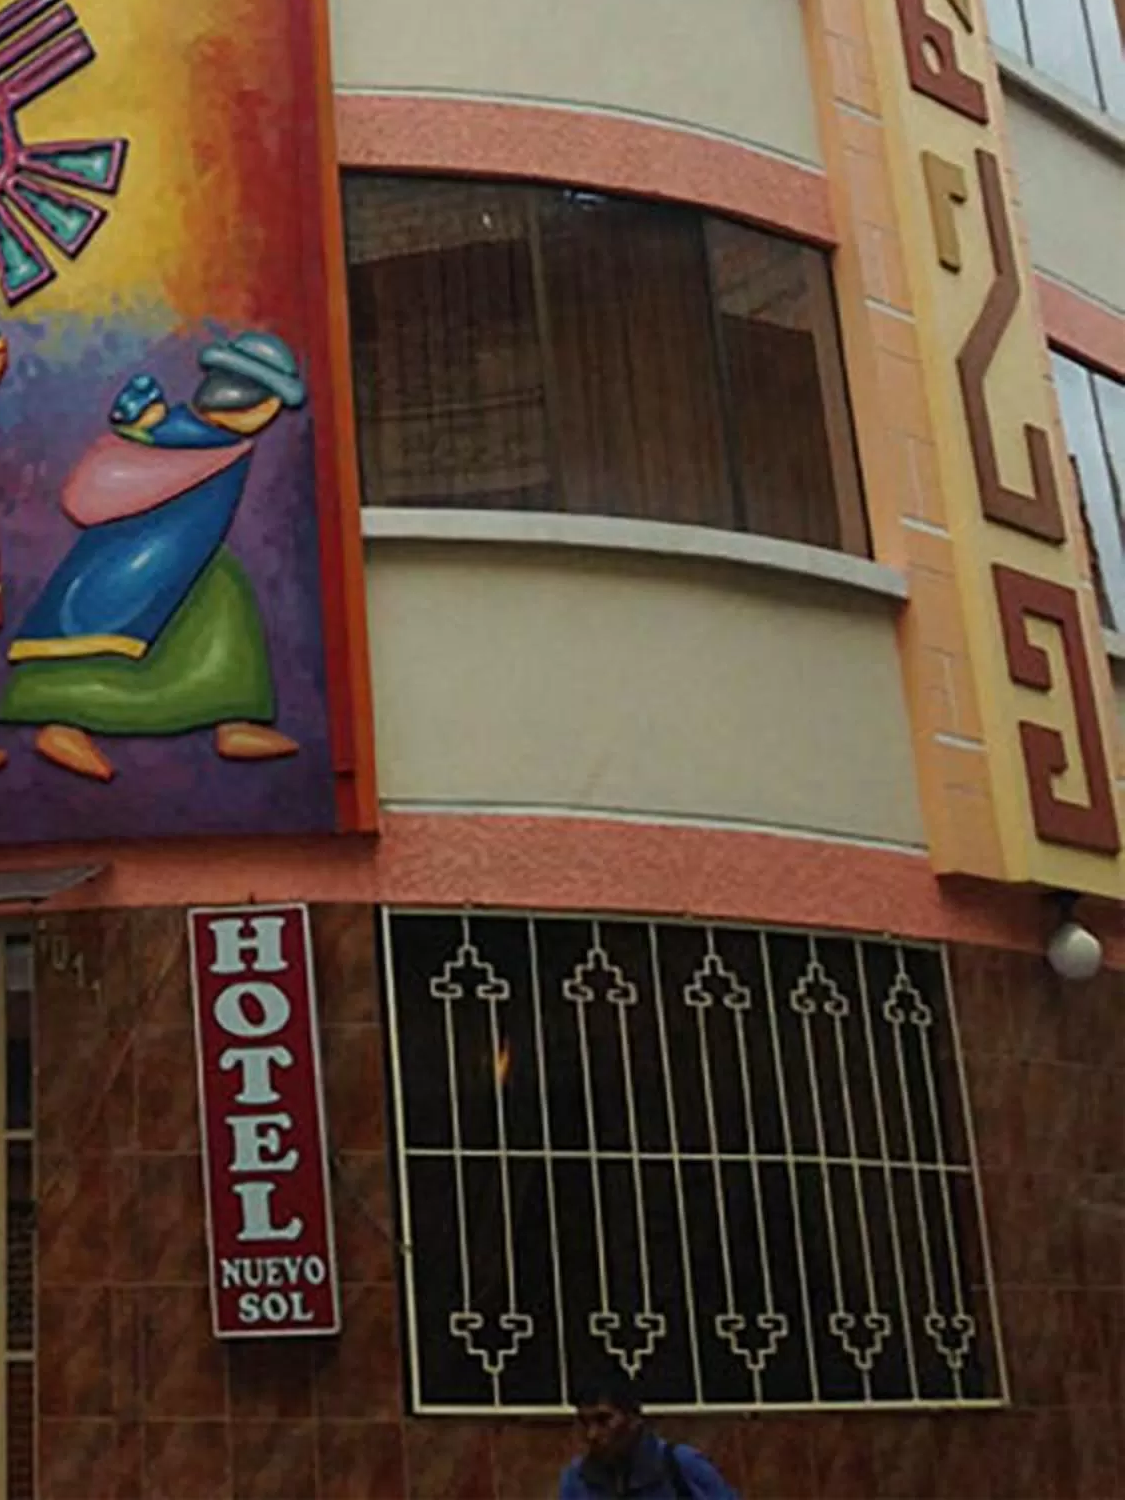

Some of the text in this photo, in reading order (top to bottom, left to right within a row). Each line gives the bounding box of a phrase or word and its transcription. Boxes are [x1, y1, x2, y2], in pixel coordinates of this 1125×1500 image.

[208, 916, 304, 1242] HOTEL
[220, 1255, 326, 1290] NUEVO
[237, 1291, 315, 1324] SOL
